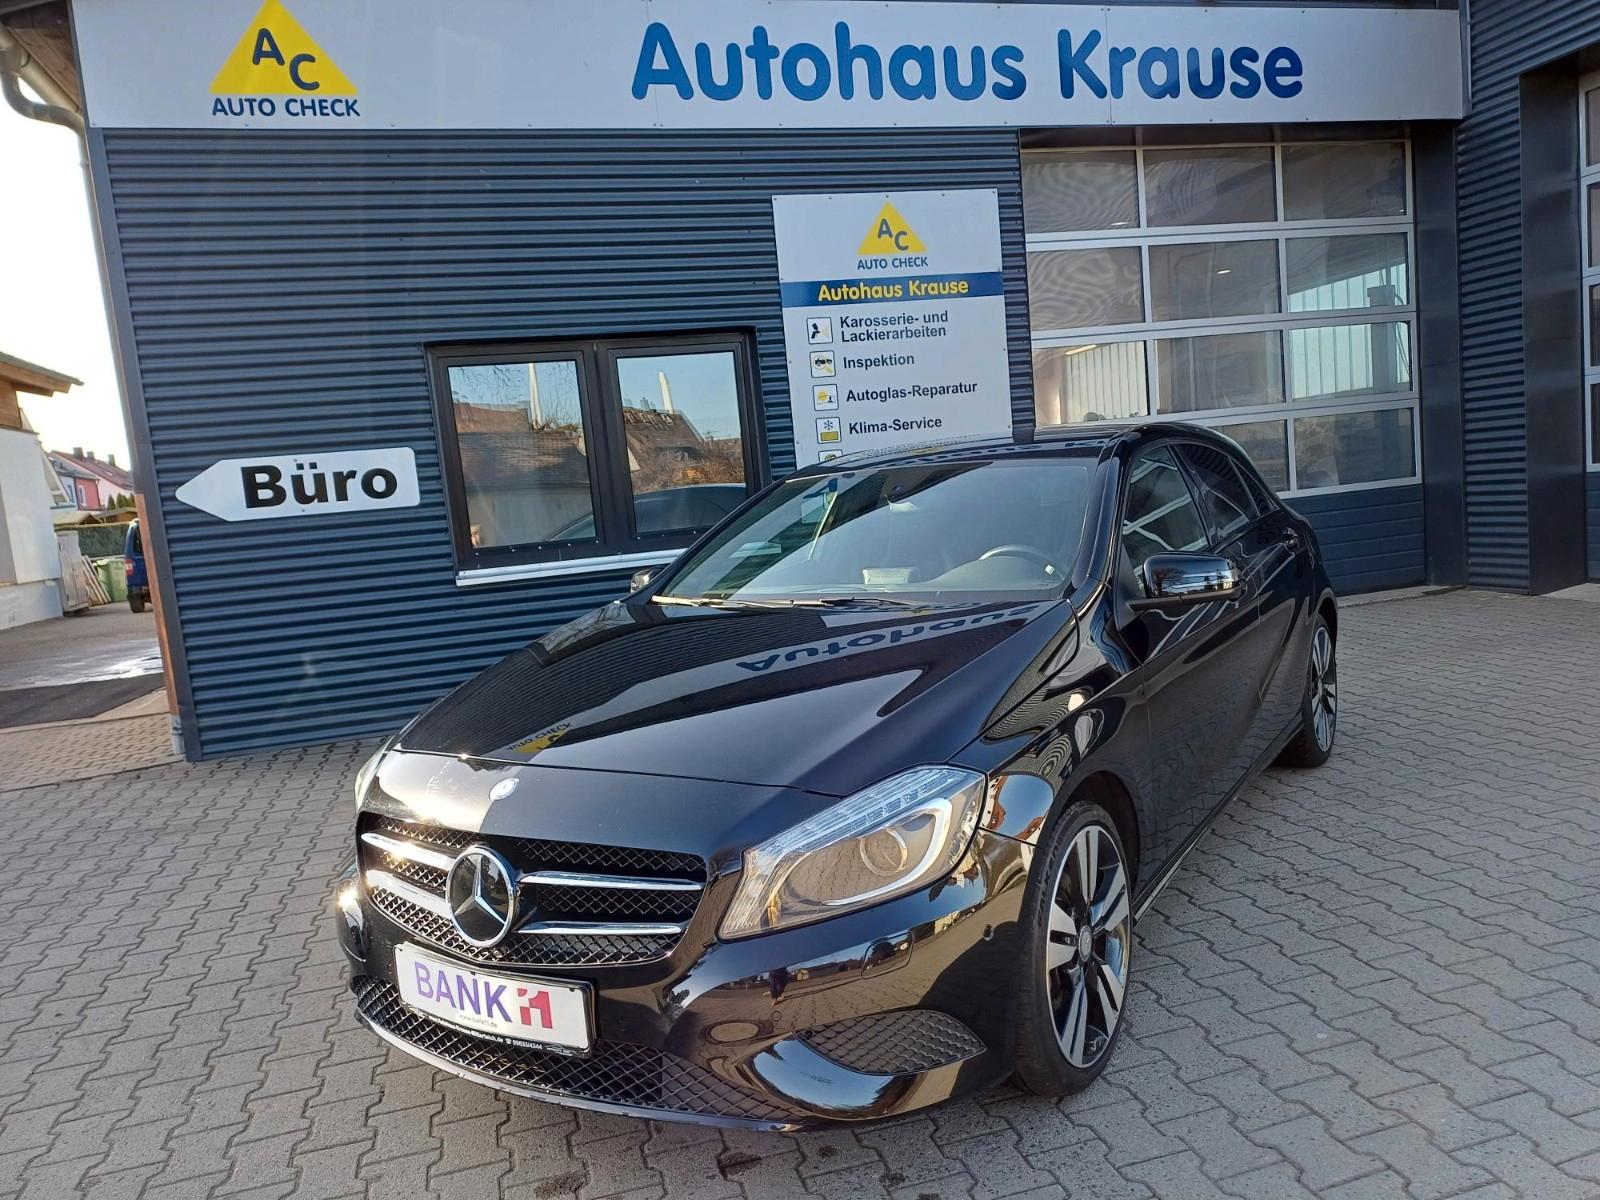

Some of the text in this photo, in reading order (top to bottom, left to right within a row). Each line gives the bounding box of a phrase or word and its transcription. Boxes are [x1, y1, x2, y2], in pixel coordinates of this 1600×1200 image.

[631, 22, 1303, 101] Autohaus Krause
[212, 97, 360, 117] AUTO CHECK
[857, 256, 929, 271] AUTO CHECK
[818, 279, 969, 302] Autohaus Krause
[840, 310, 949, 329] Karosserie- und
[841, 326, 946, 343] Lackierarbeiten
[843, 354, 915, 371] Inspektion
[846, 381, 978, 403] Autoglas-Reparatur
[849, 417, 942, 435] Klima-Service
[241, 462, 397, 508] Büro
